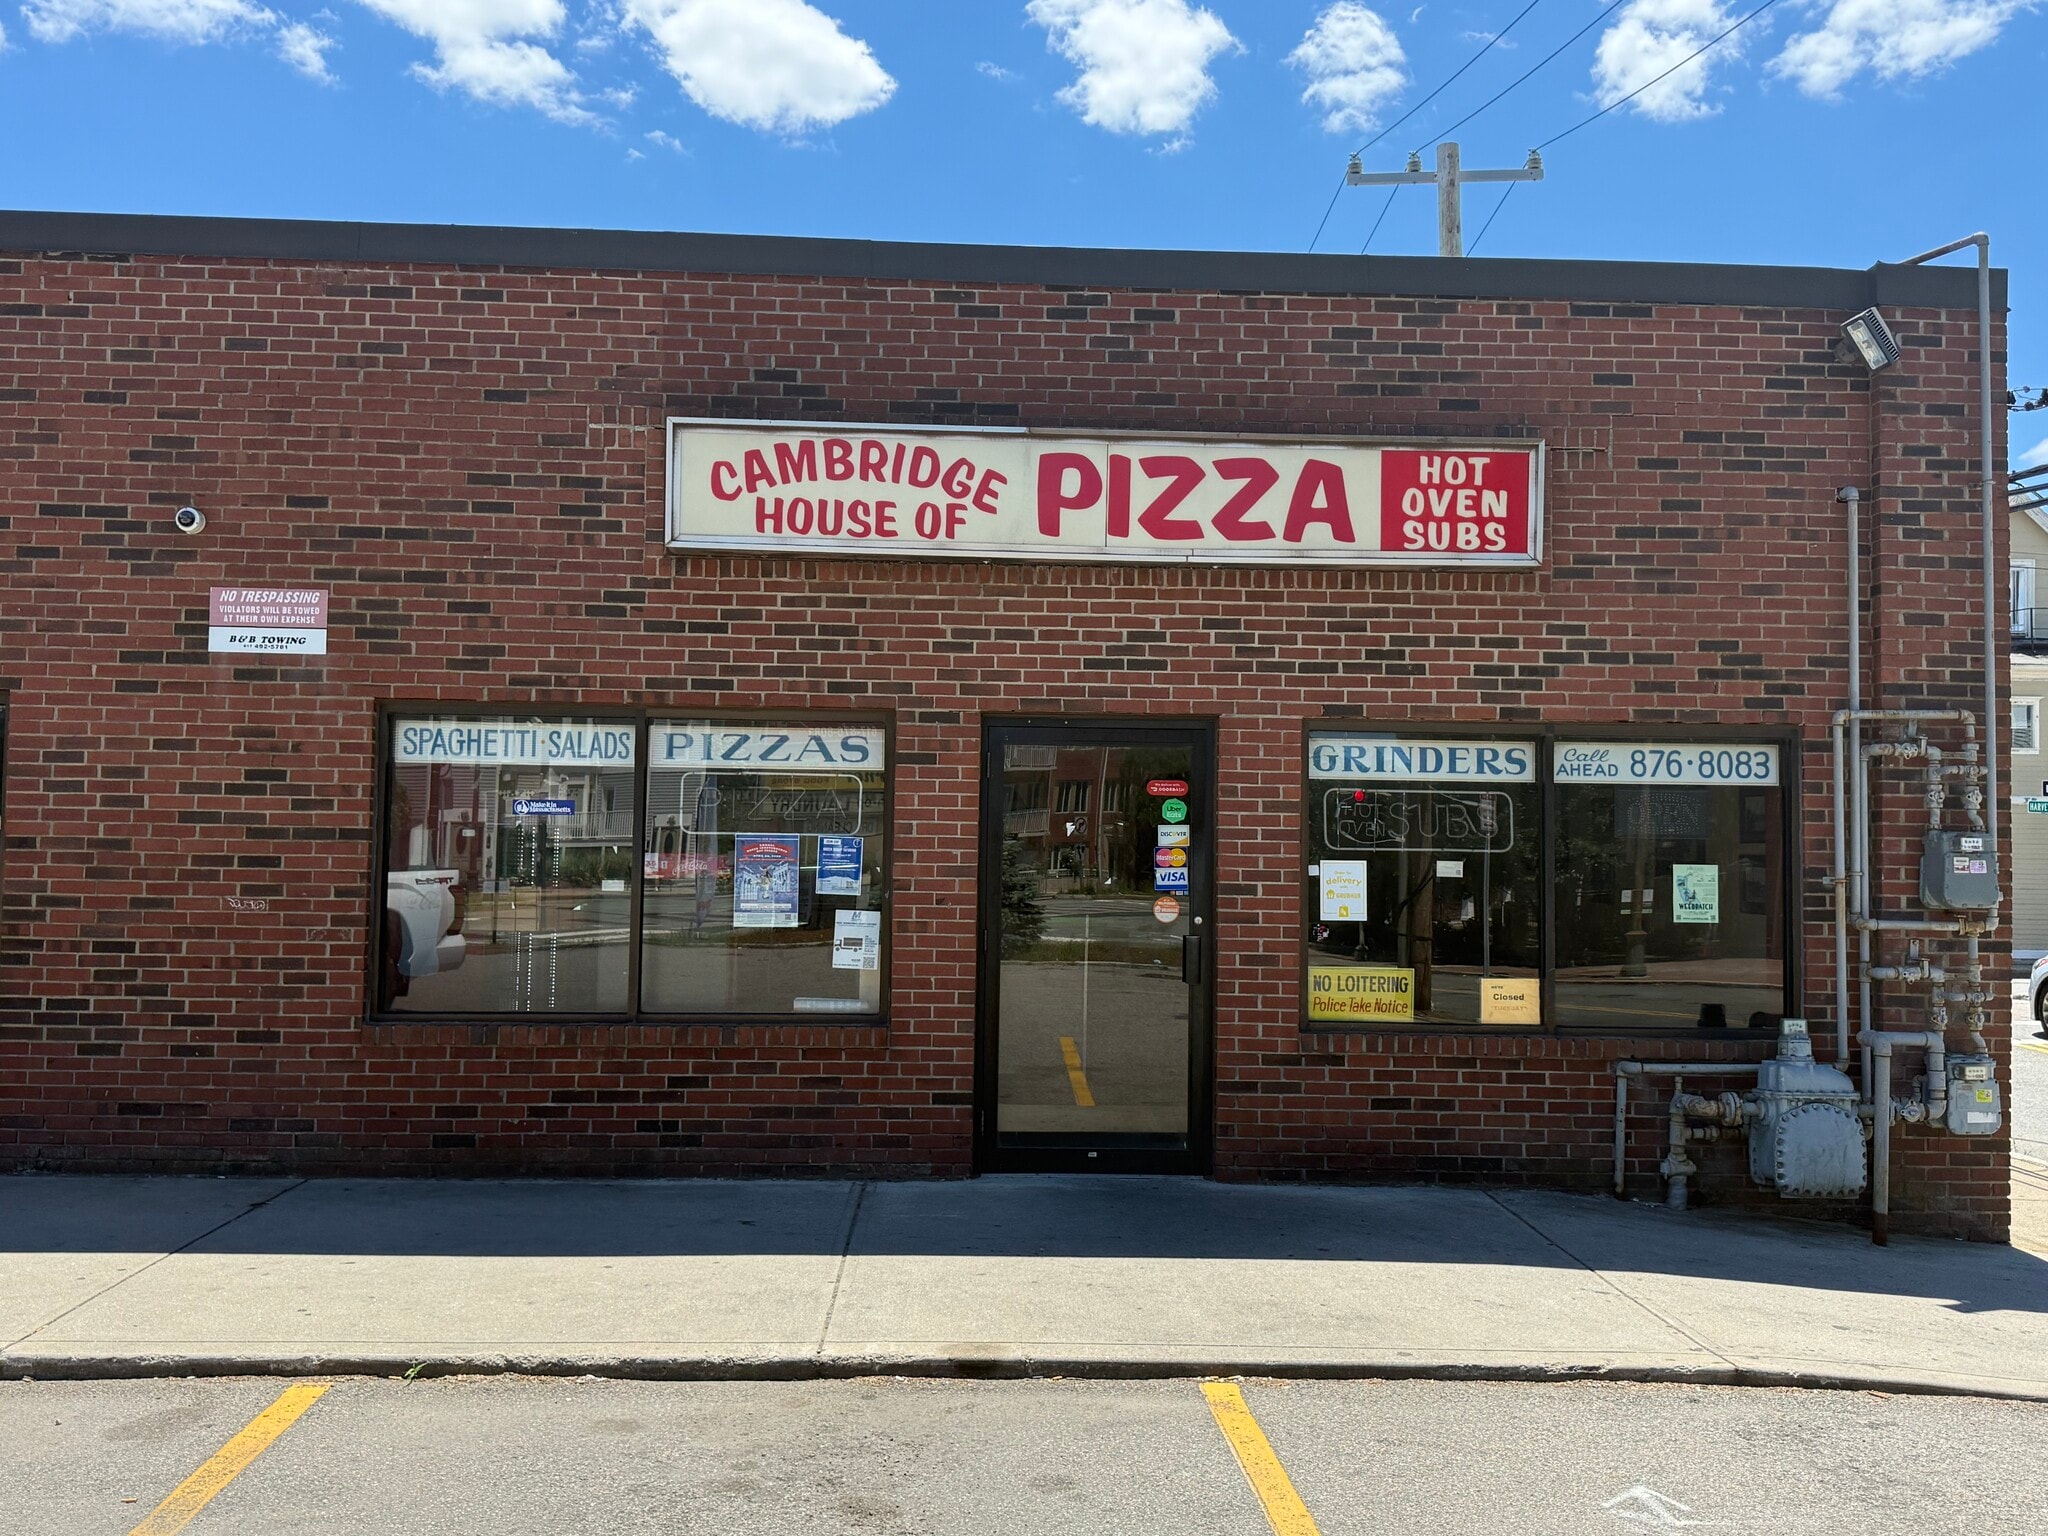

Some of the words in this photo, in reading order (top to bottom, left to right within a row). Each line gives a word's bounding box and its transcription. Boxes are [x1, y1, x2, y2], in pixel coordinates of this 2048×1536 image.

[710, 438, 1008, 515] CAMBRIDGE
[1419, 456, 1491, 486] HOT
[1037, 452, 1356, 543] PIZZA
[1401, 487, 1508, 518] OVEN
[755, 497, 899, 538] HOUSE
[914, 501, 968, 540] OF
[1402, 519, 1507, 552] SUBS
[219, 590, 237, 602] NO
[240, 590, 320, 604] TRESPASSING
[219, 605, 261, 614] VIOLATORS
[262, 605, 280, 614] WILL
[282, 606, 292, 615] BE
[294, 606, 320, 615] TOWED
[223, 614, 233, 622] AT
[236, 615, 258, 623] THEIR
[260, 615, 279, 623] OWN
[281, 616, 316, 624] EXPENSE
[261, 636, 307, 645] TOWING
[403, 727, 537, 757] SPAGHETTI
[548, 730, 631, 760] SALADS
[663, 732, 870, 763] PIZZAS
[1312, 744, 1528, 775] GRINDERS
[1563, 748, 1610, 763] Call
[1556, 763, 1619, 777] AHEAD
[697, 786, 847, 821] PIZZA
[1160, 871, 1186, 882] VISA
[1326, 876, 1361, 886] delivery
[1313, 975, 1332, 992] NO
[1337, 975, 1409, 994] LOITERING
[1313, 996, 1347, 1012] Police
[1349, 997, 1371, 1013] Take
[1373, 998, 1408, 1014] Notice
[1493, 993, 1525, 1001] Closed
